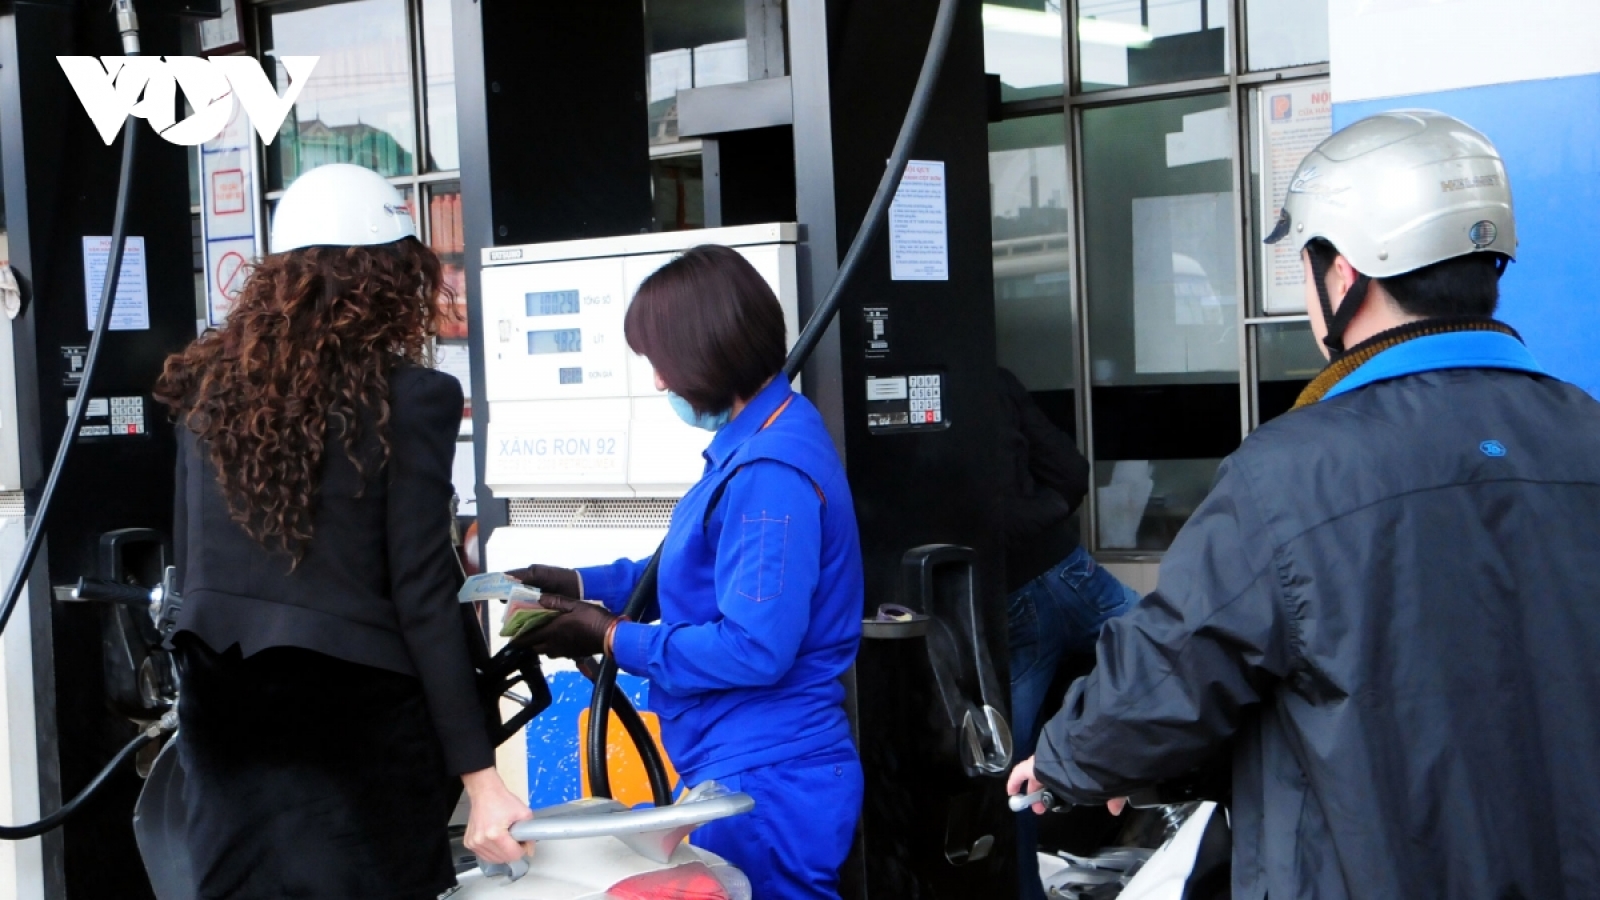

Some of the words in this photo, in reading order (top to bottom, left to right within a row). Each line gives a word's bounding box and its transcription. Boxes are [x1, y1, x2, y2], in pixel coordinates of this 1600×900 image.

[498, 435, 547, 457] XĂNG
[552, 437, 591, 456] RON
[596, 436, 616, 456] 92
